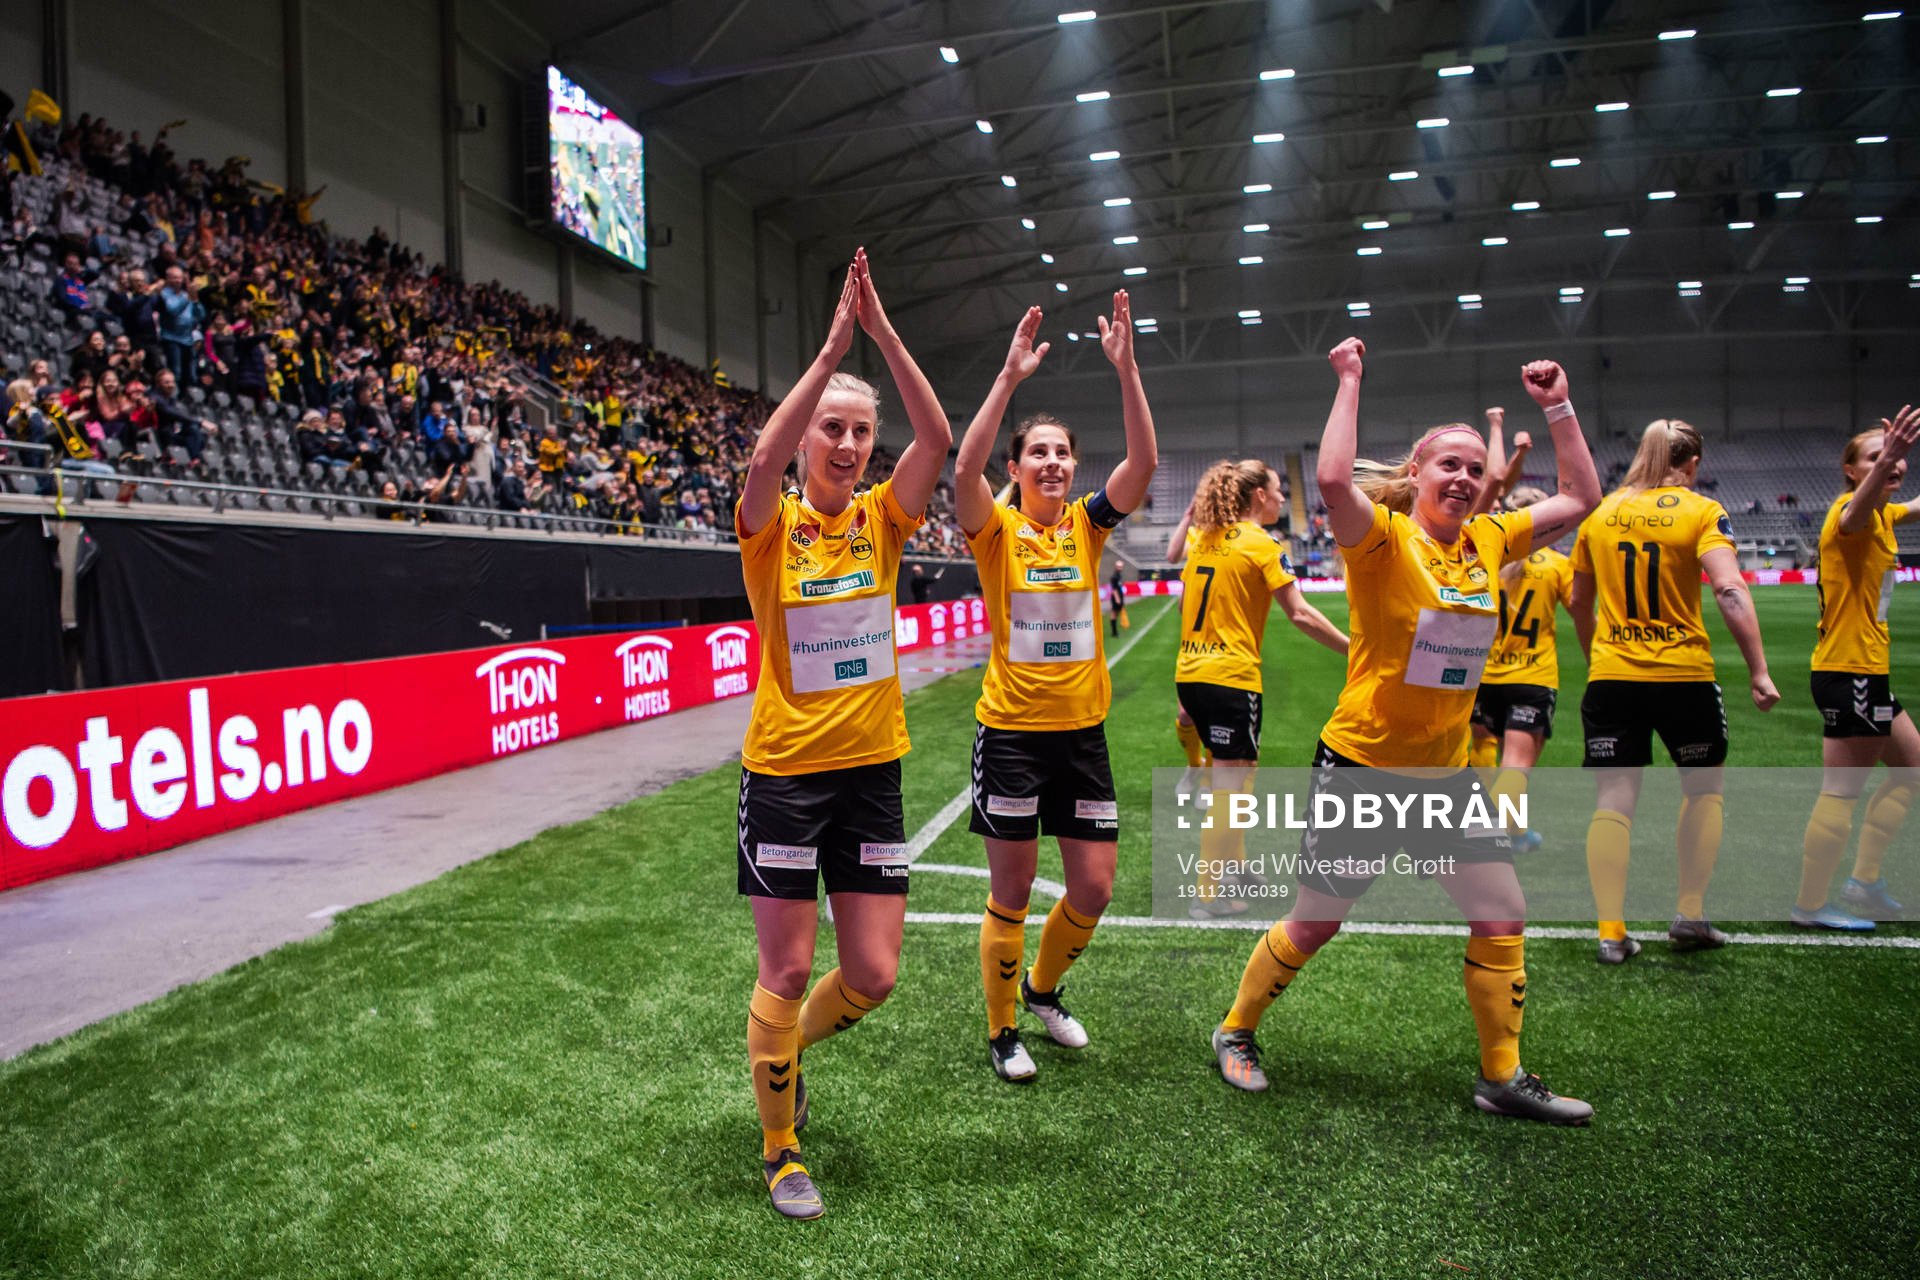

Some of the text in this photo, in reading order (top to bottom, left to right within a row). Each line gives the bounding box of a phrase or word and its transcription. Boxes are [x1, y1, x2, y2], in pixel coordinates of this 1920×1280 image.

[1605, 507, 1674, 534] dynea
[805, 577, 861, 596] Franzefoss
[1617, 541, 1660, 620] 11
[1192, 565, 1216, 632] 7
[792, 628, 892, 655] #huninvesterer
[1013, 619, 1092, 632] #huninvesterer
[615, 635, 673, 688] THON
[705, 626, 750, 671] THON
[1046, 644, 1069, 655] DNB
[476, 648, 566, 714] THON
[713, 671, 748, 699] HOTELS
[838, 661, 864, 677] DNB
[624, 689, 671, 721] HOTELS
[492, 711, 559, 755] HOTELS
[1, 687, 374, 850] otels.no
